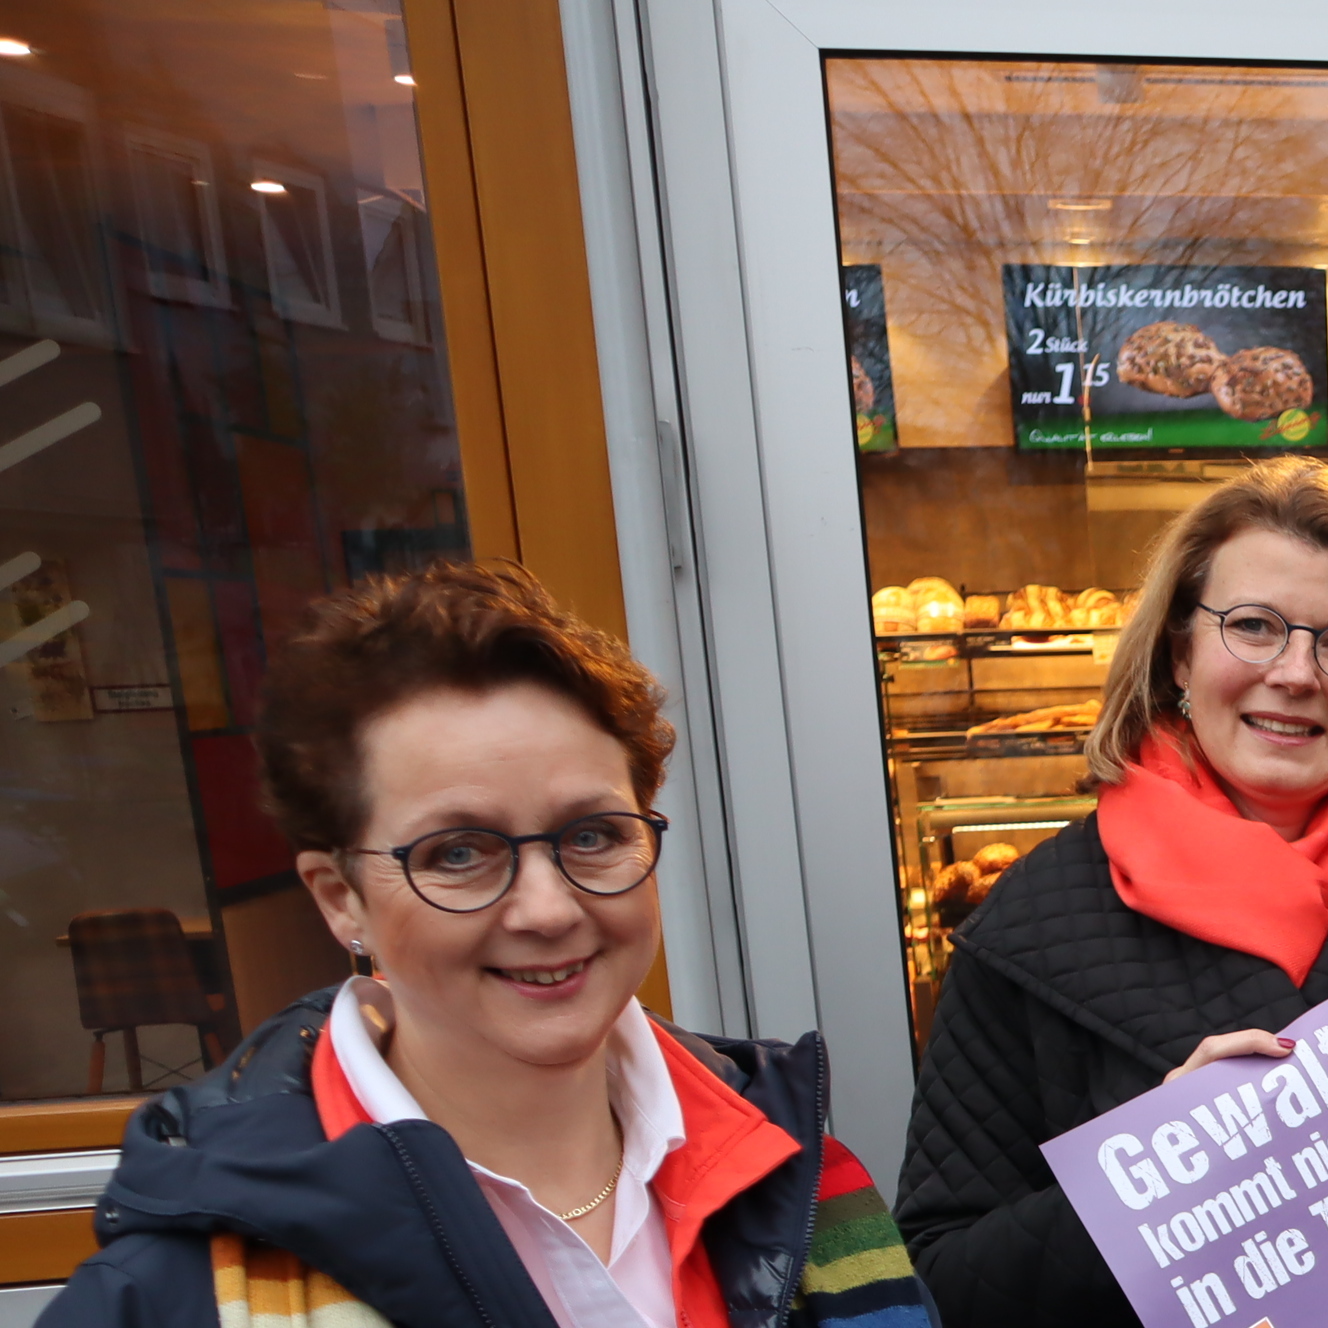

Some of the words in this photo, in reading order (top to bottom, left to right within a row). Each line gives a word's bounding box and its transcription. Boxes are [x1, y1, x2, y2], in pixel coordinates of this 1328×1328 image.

[1023, 282, 1307, 309] Kürbiskernbrötchen
[1138, 1157, 1295, 1266] kommt
[1234, 1228, 1314, 1298] die
